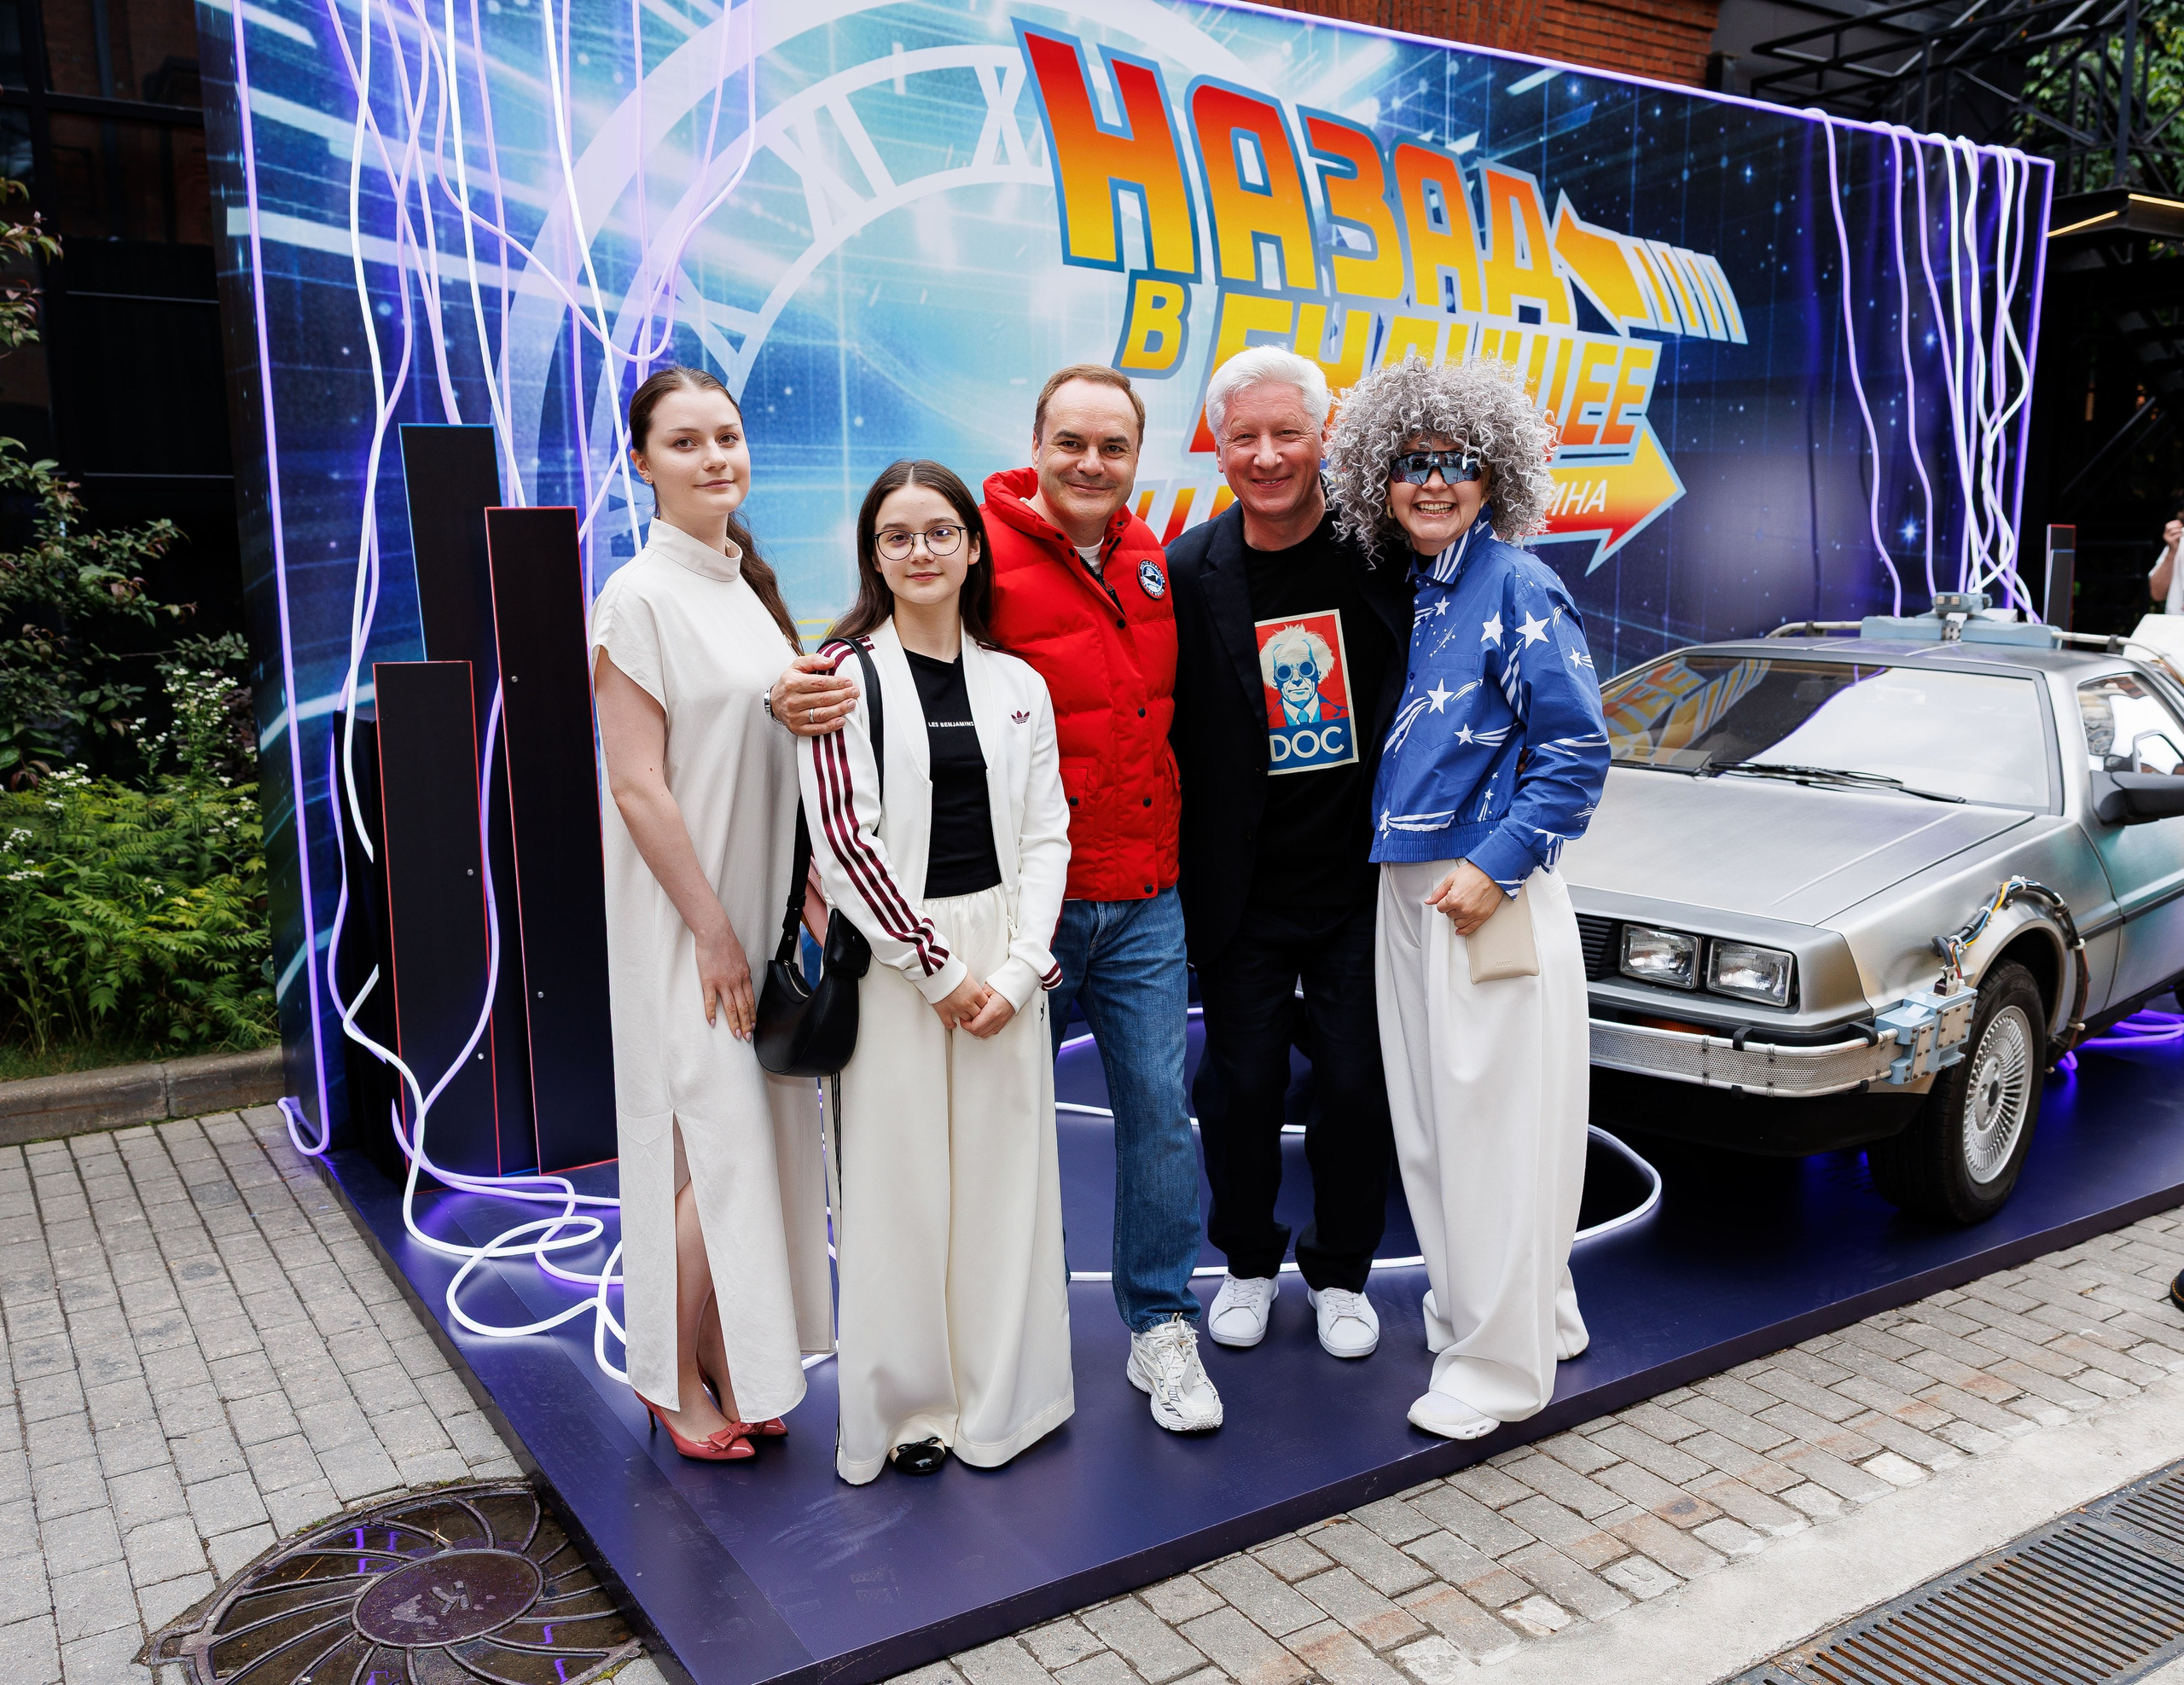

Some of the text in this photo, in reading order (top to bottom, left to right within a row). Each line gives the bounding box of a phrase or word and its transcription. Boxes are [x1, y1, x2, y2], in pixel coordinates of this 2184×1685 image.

[1017, 24, 1572, 327] НАЗАД
[1120, 280, 1187, 371] В
[1269, 726, 1345, 763] DOC
